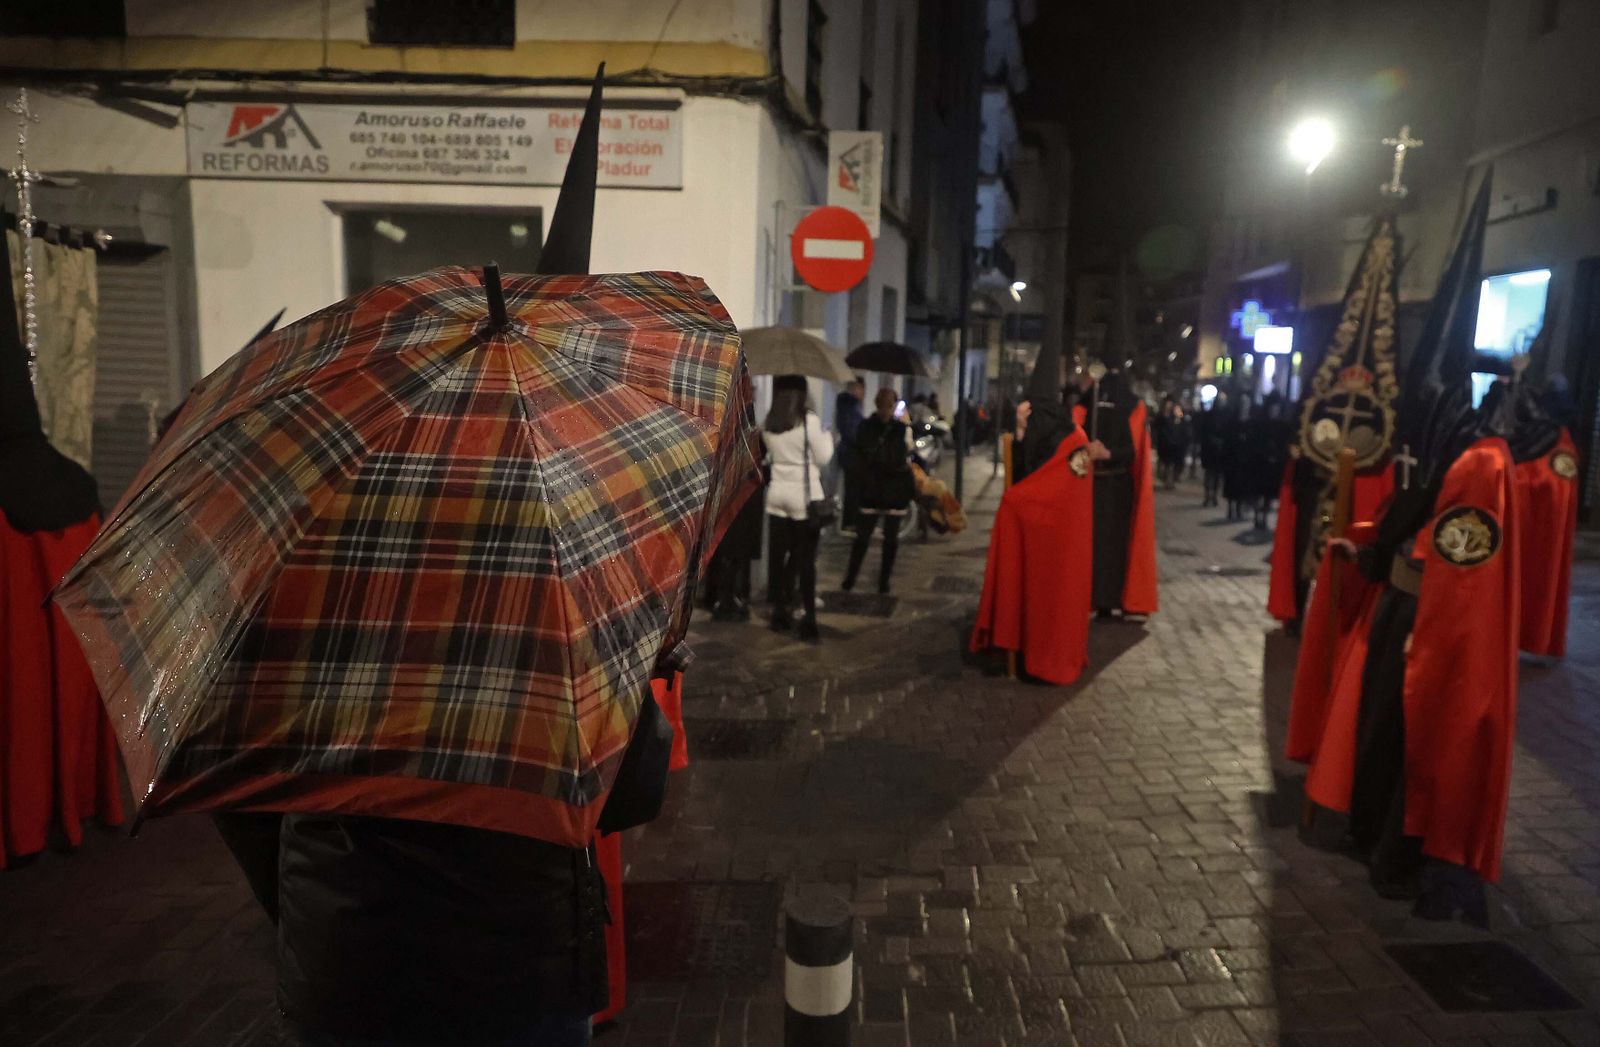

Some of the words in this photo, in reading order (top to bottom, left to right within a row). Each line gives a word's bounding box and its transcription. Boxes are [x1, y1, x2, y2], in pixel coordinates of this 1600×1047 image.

[355, 111, 443, 128] Amoruso
[446, 113, 527, 129] Raffaele
[548, 112, 622, 130] Refma
[628, 113, 670, 131] Total
[554, 137, 663, 157] Eloración
[202, 152, 330, 173] REFORMAS
